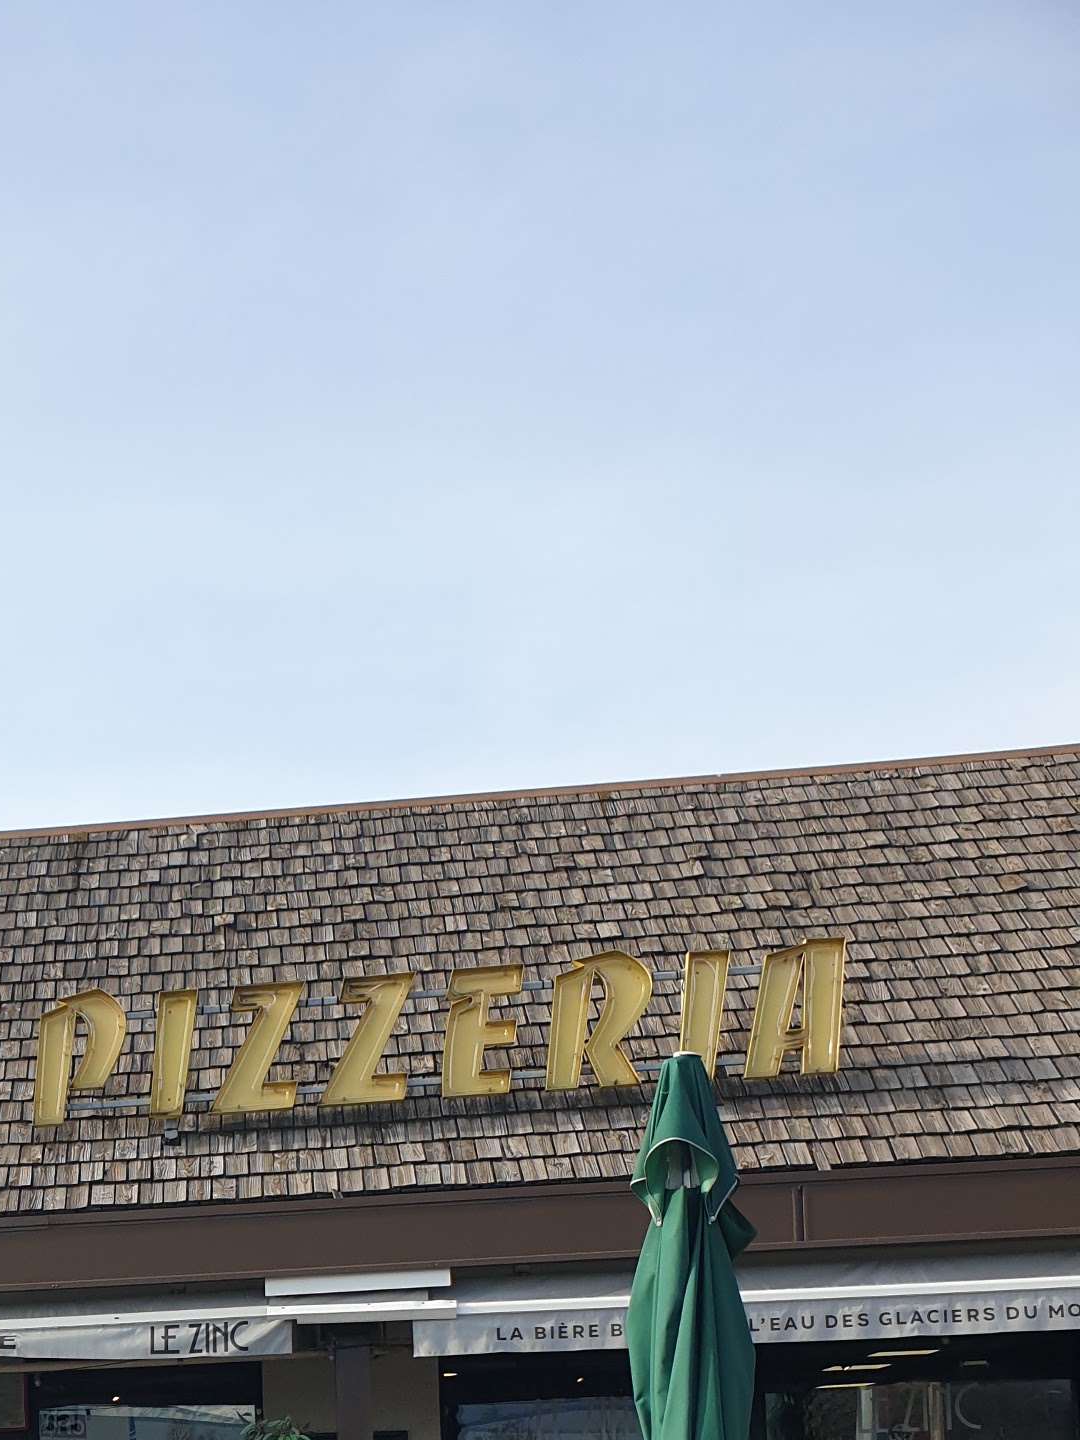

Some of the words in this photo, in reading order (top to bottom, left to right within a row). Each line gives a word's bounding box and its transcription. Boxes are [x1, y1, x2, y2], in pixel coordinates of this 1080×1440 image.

[33, 937, 847, 1127] PIZZERIA
[150, 1324, 180, 1354] LE
[188, 1320, 249, 1354] ZINC
[496, 1327, 524, 1341] LA
[534, 1322, 599, 1340] BIÈRE
[749, 1315, 815, 1332] L'EAU
[825, 1313, 870, 1329] DES
[878, 1306, 997, 1326] GLACIERS
[1006, 1305, 1039, 1320] DU
